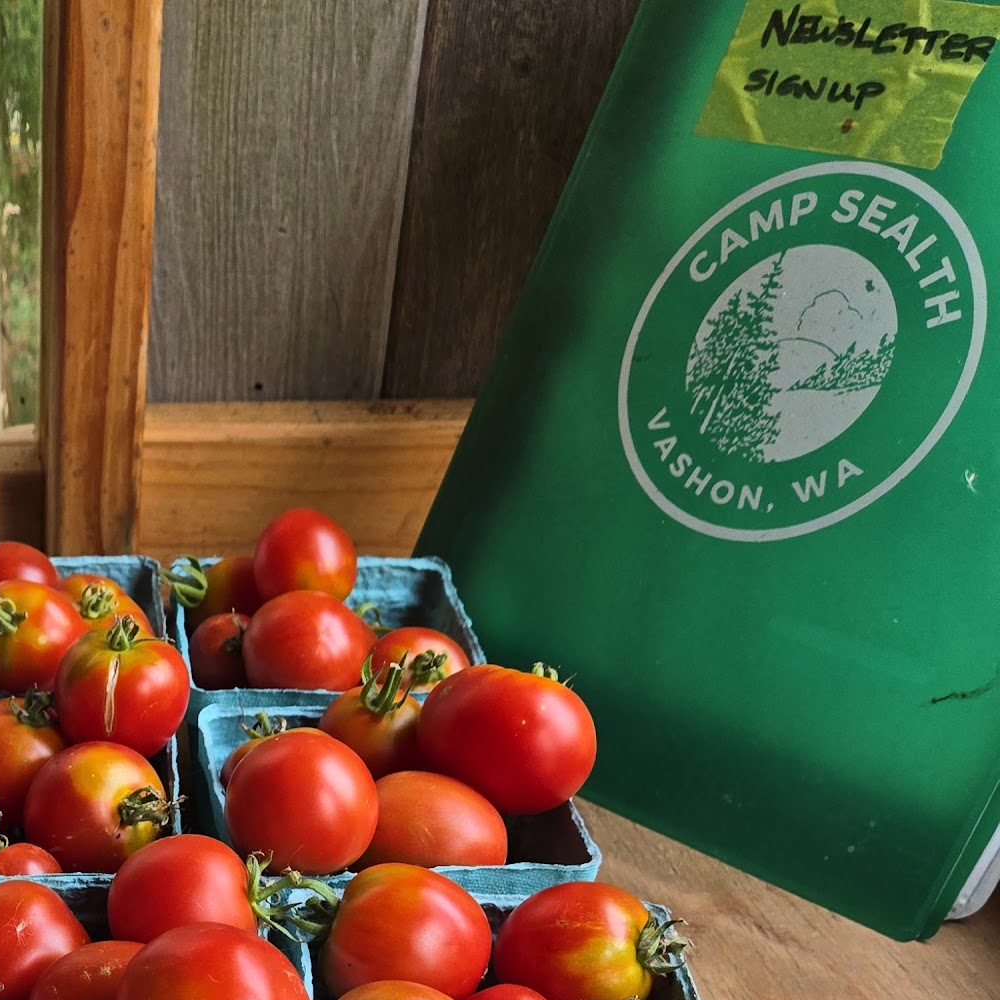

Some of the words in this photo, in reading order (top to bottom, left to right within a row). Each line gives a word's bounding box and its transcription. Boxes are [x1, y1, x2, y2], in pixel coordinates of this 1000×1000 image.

[761, 4, 998, 63] NEWSLETTER
[688, 190, 819, 283] CAMP
[831, 188, 962, 330] SEALTH
[646, 406, 775, 514] VASHON,
[791, 457, 865, 503] WA
